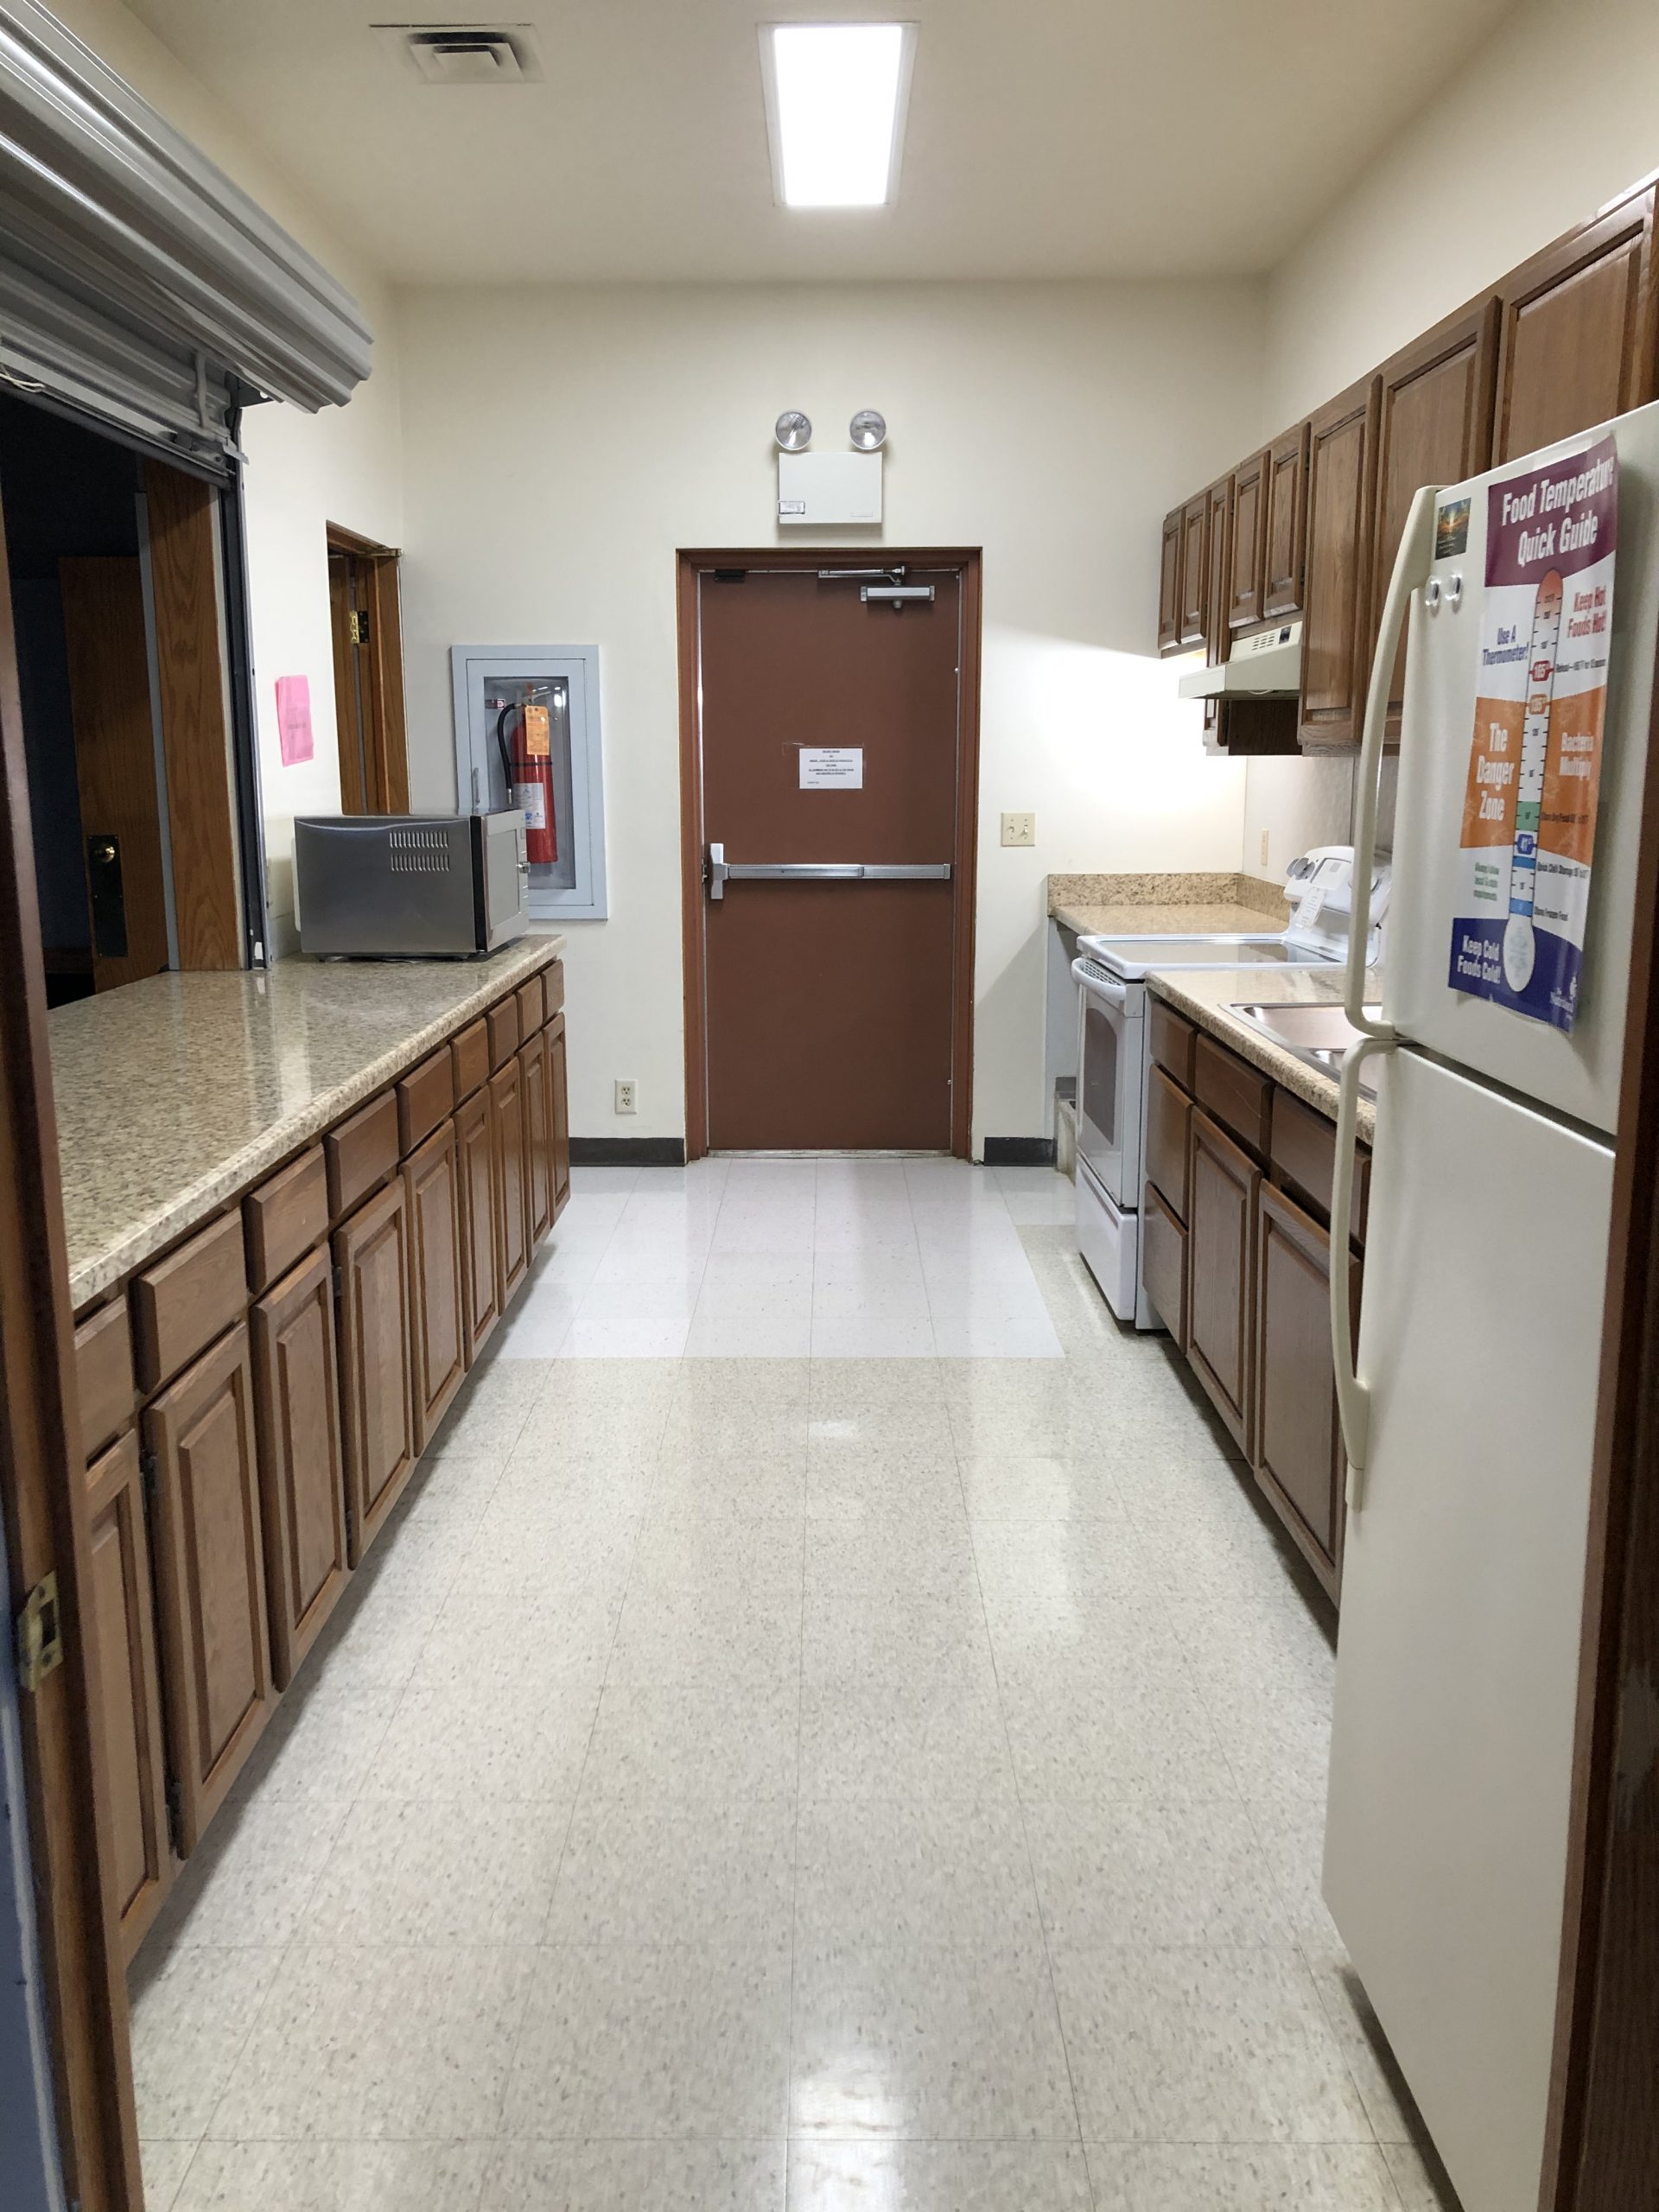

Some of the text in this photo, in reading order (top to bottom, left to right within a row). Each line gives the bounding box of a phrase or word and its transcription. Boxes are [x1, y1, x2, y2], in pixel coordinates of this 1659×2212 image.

[1502, 484, 1537, 526] Food
[1517, 510, 1599, 568] Quick Guide
[1497, 626, 1510, 645] Use
[1489, 722, 1509, 752] The
[1476, 754, 1515, 791] Danger
[1478, 790, 1505, 821] Zone
[1462, 935, 1483, 960] Keep
[1483, 939, 1500, 961] Cold
[1457, 955, 1481, 978] Foods
